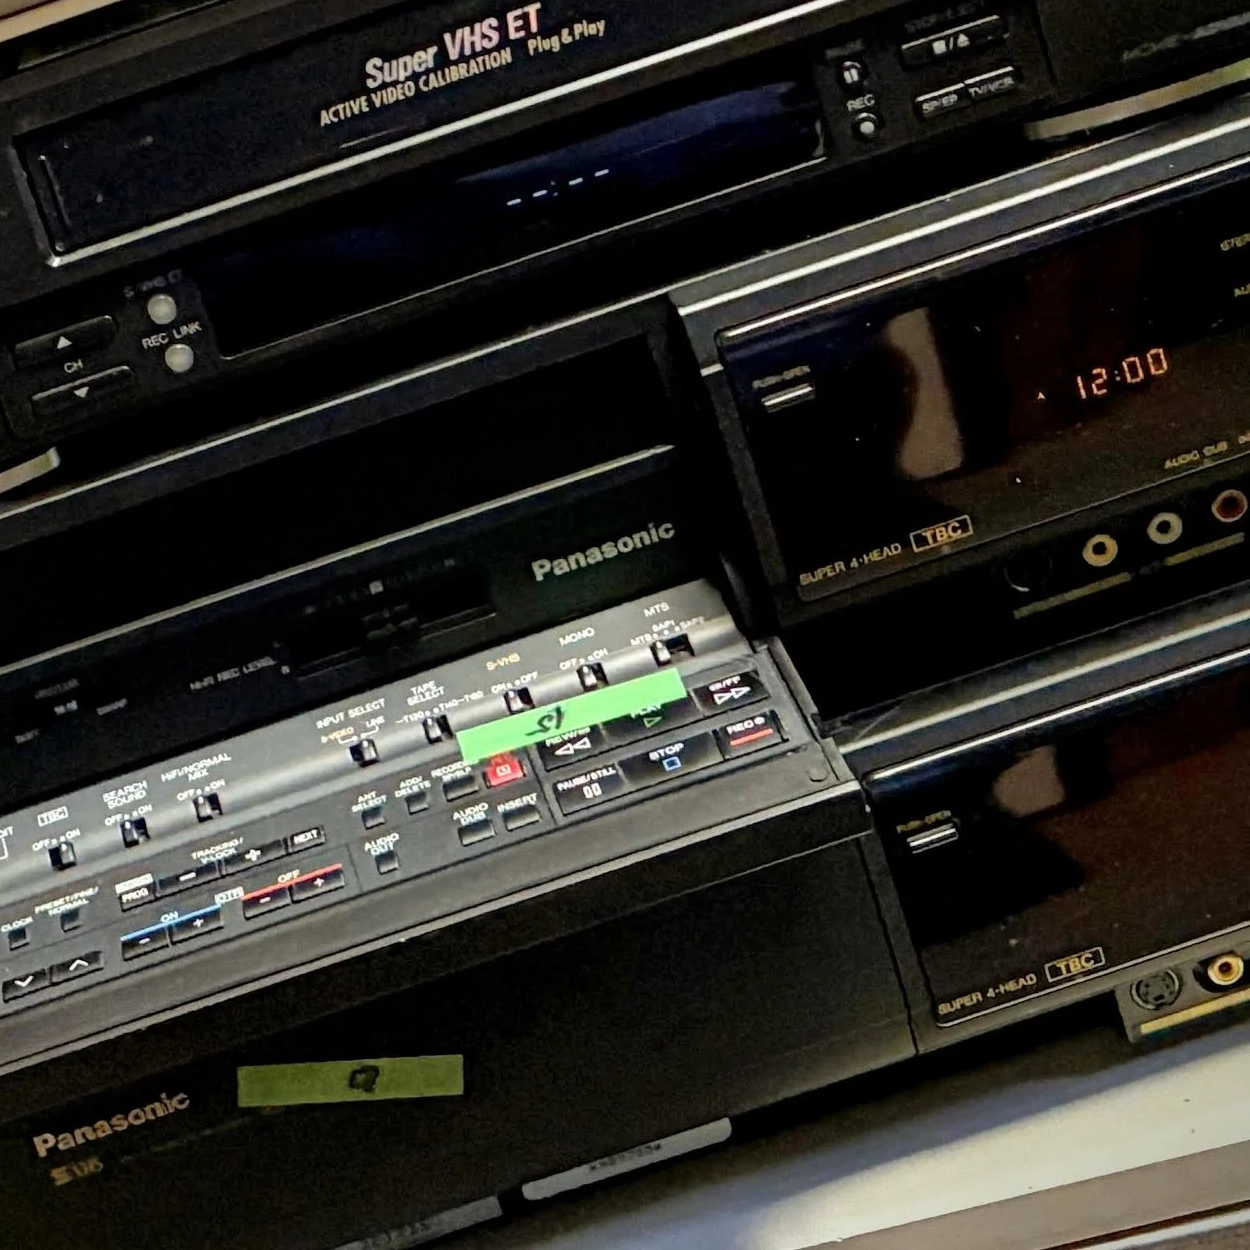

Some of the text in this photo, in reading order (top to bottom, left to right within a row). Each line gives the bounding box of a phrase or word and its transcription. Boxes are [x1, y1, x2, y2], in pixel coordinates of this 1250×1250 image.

[365, 2, 542, 90] Super VHS ET
[320, 46, 513, 128] ACTIVE VIDEO CALIBRATION
[142, 320, 203, 350] REC LINK
[63, 359, 84, 374] CH
[1077, 348, 1169, 400] 12:00
[531, 518, 676, 582] Panasonic
[799, 521, 962, 587] SUPER TBC
[643, 601, 669, 618] MTS
[558, 626, 596, 647] MONO
[407, 686, 445, 707] SELECT
[410, 680, 437, 696] TAPE
[316, 697, 386, 730] INPUT SELECT
[648, 742, 684, 761] STOP
[102, 780, 147, 801] SEARCH
[394, 779, 431, 798] DELETE
[107, 790, 147, 810] SOUND
[496, 793, 538, 813] INSERT
[452, 802, 489, 821] AUDIO
[363, 832, 400, 852] AUDIO
[0, 916, 34, 933] CLOCK
[937, 991, 983, 1016] SUPER
[1055, 952, 1096, 977] TBC
[32, 1092, 191, 1158] Panasonic
